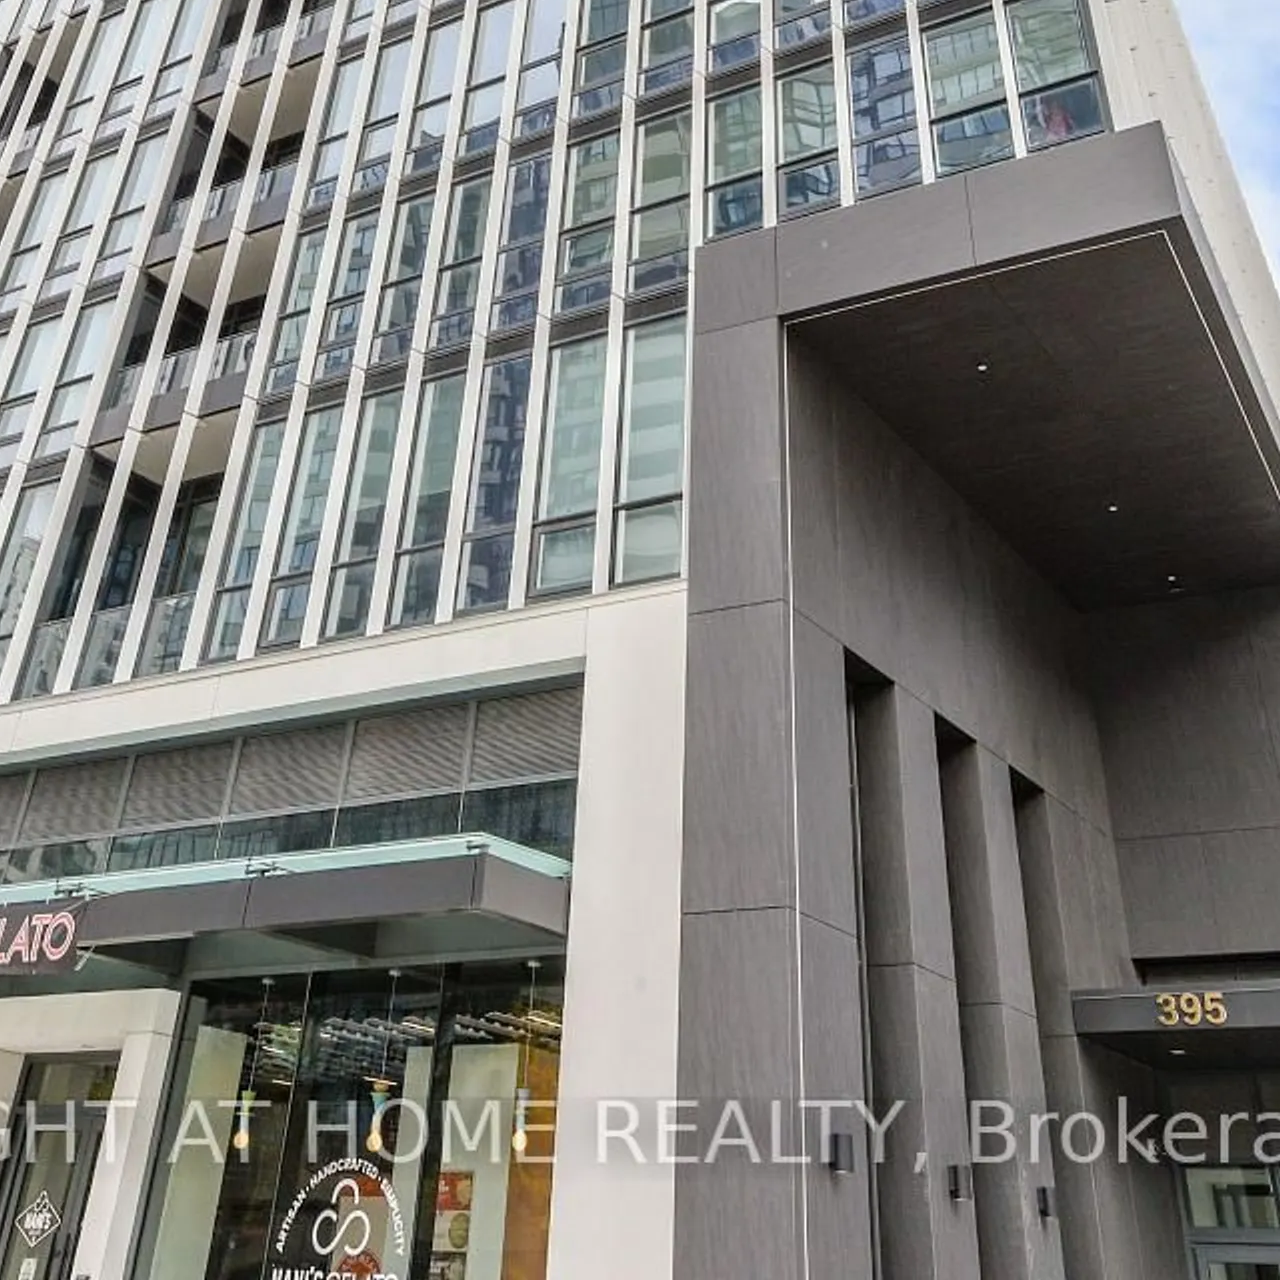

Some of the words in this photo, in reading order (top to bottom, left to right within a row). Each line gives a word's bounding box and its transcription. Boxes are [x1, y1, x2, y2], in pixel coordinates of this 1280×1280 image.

[1155, 991, 1228, 1027] 395
[276, 1188, 308, 1254] ARTISAN
[309, 1157, 380, 1189] HANDCRAFTED
